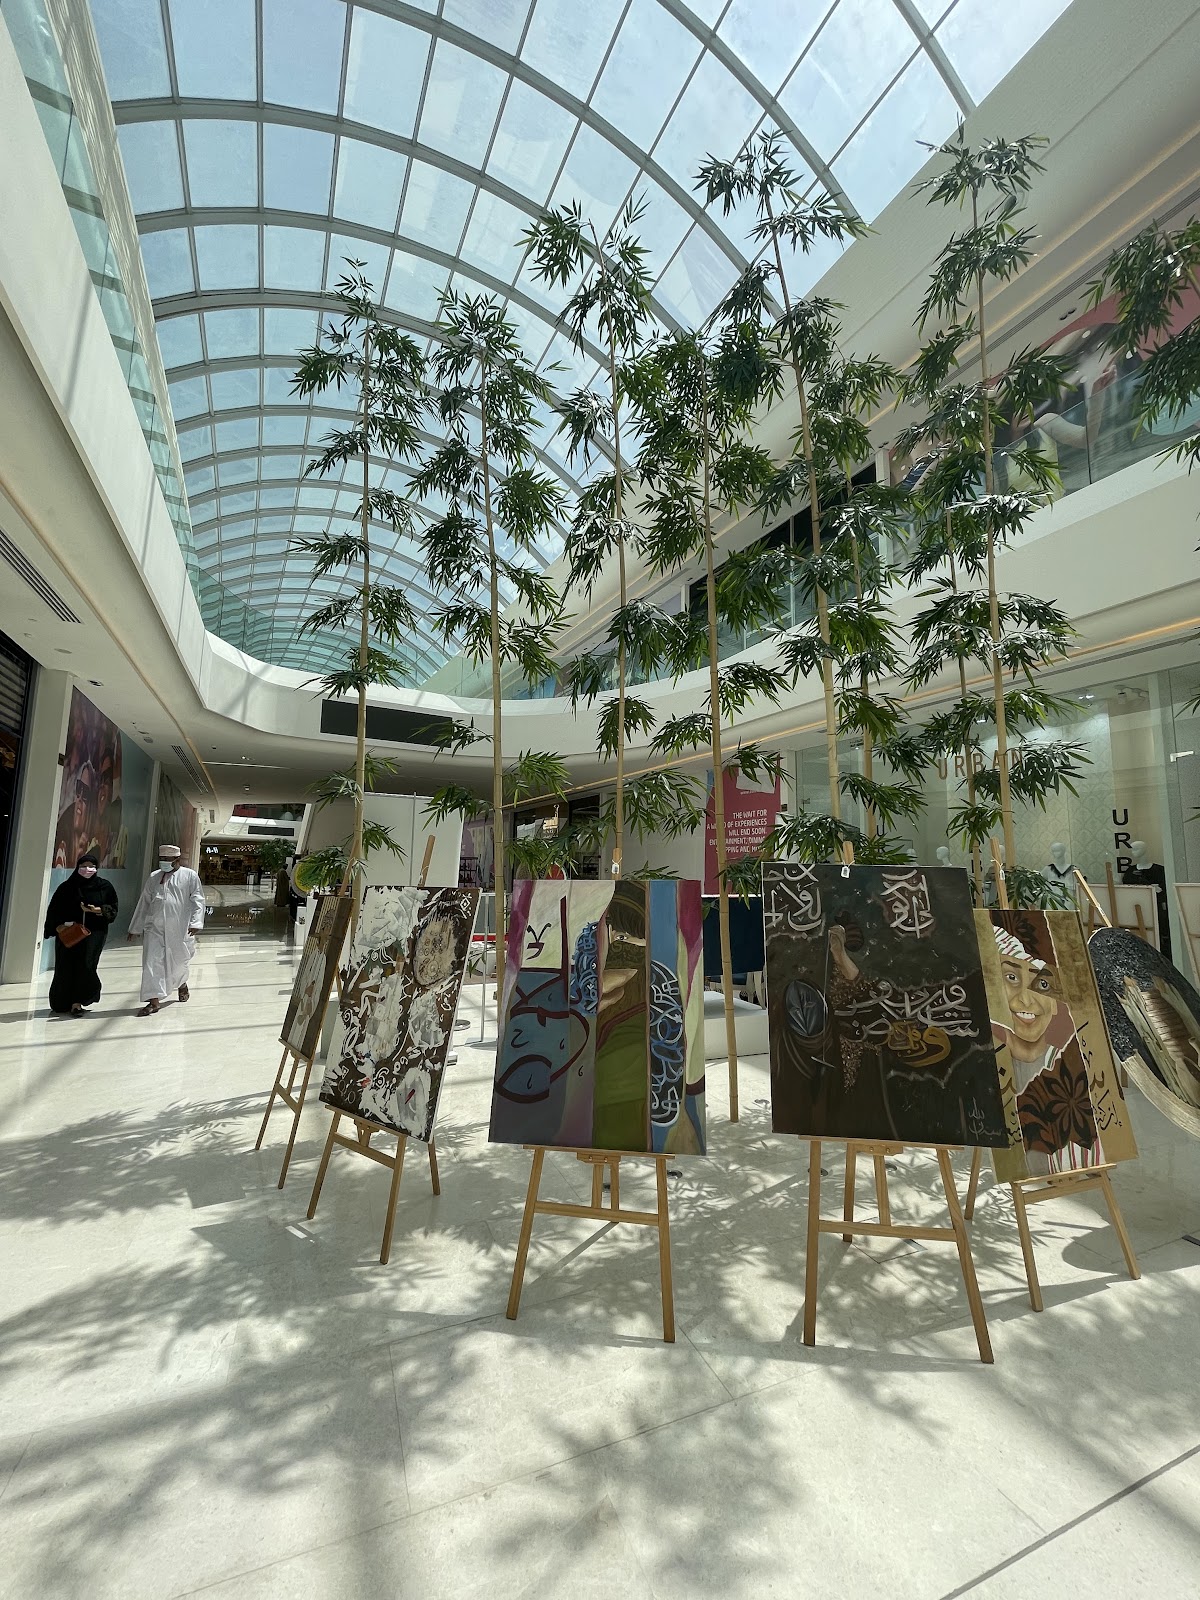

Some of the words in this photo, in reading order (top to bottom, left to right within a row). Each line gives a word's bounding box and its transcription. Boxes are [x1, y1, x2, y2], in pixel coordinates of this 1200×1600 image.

[743, 810, 756, 819] WAIT
[757, 809, 768, 818] FOR
[735, 818, 767, 827] EXPERIENCES
